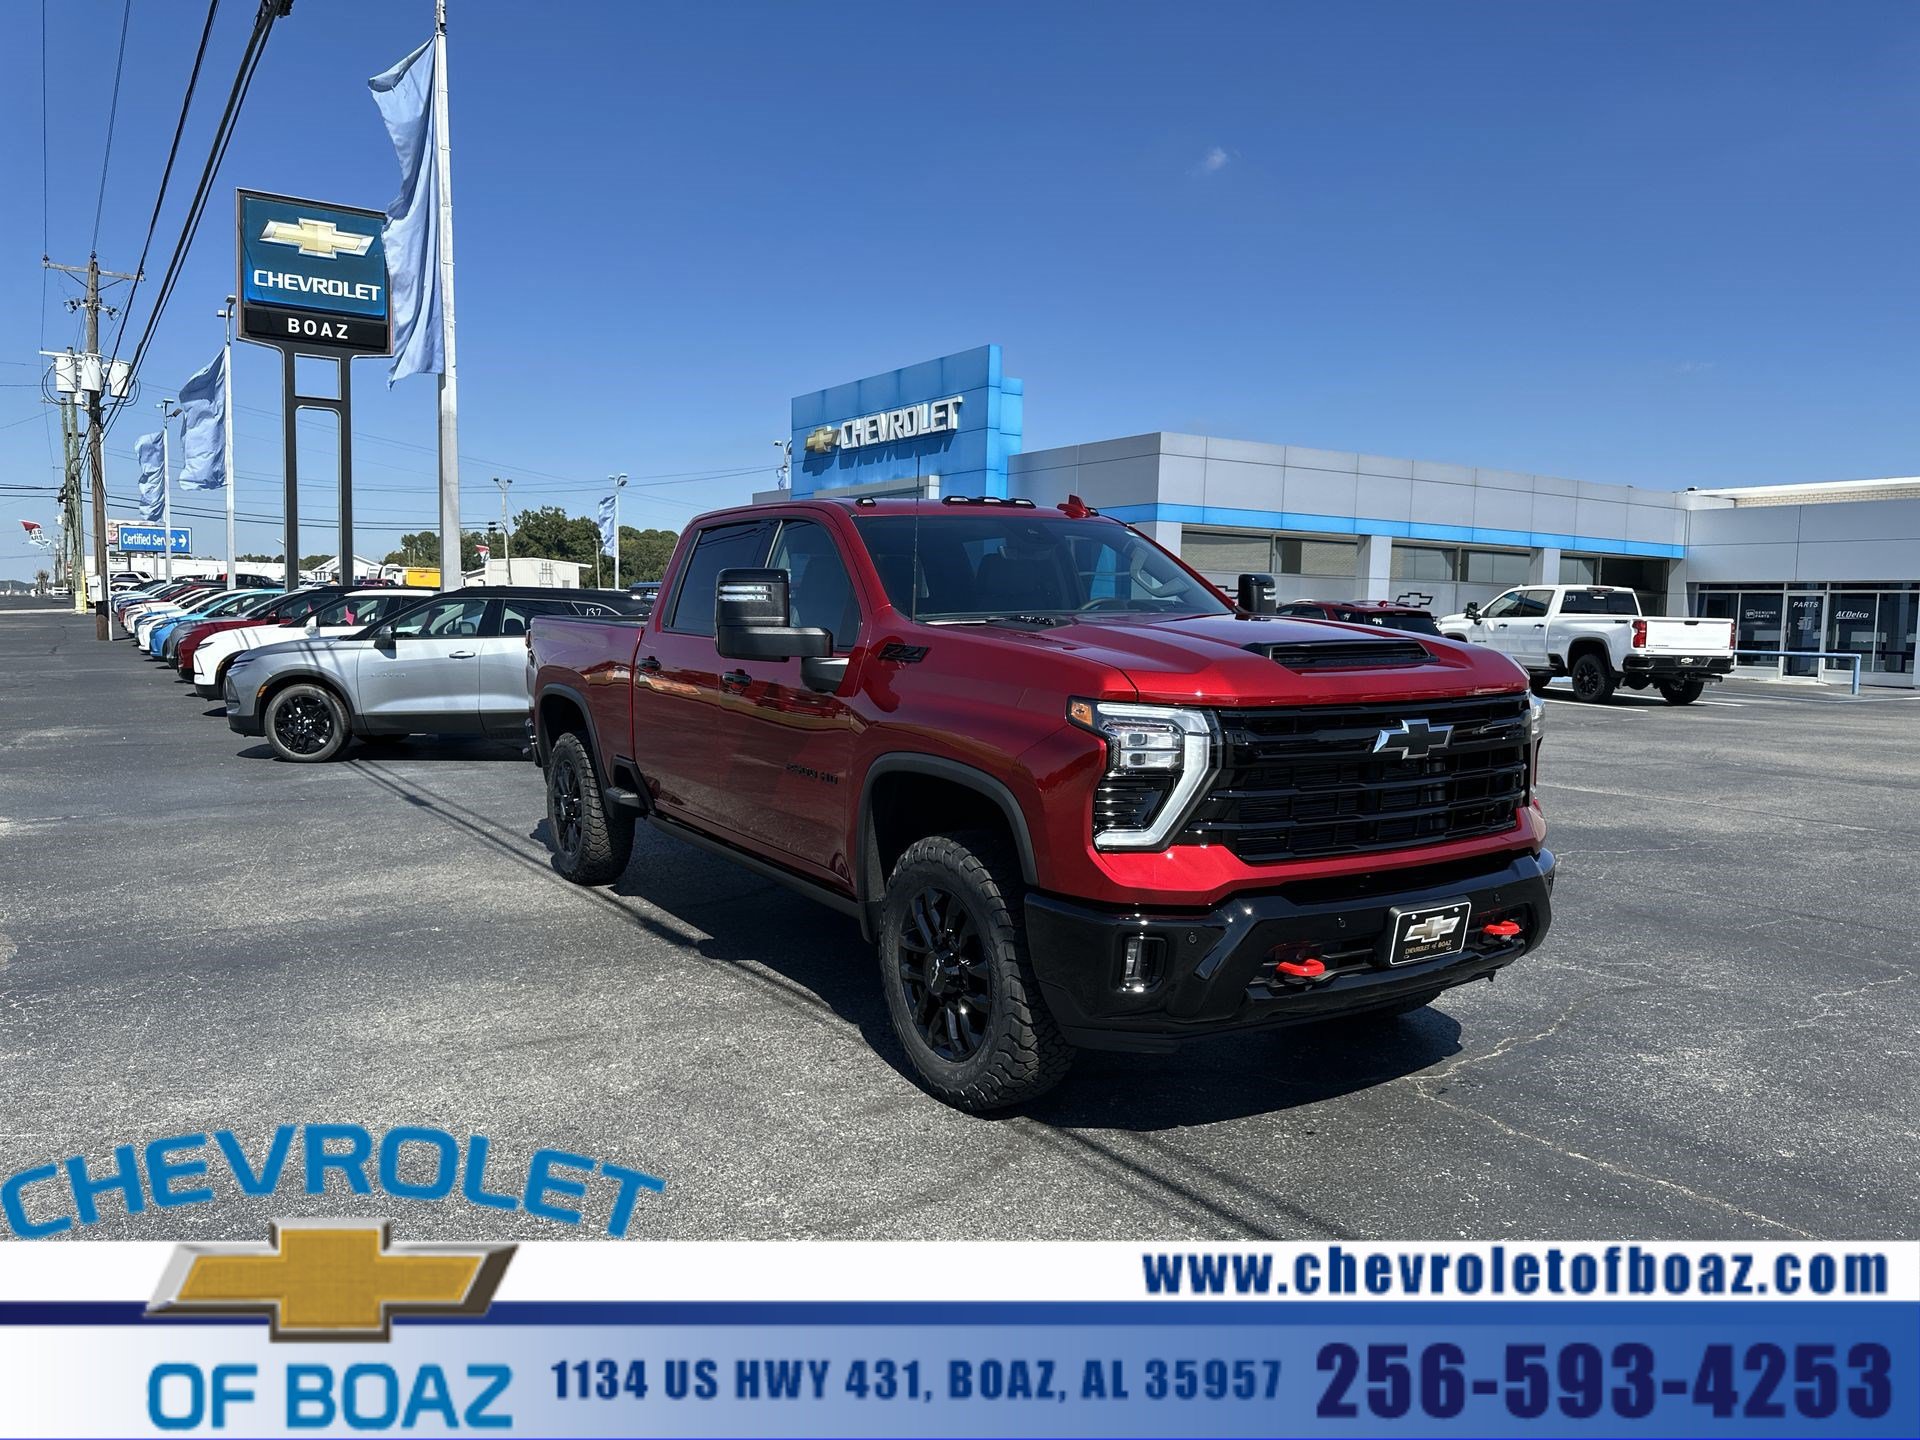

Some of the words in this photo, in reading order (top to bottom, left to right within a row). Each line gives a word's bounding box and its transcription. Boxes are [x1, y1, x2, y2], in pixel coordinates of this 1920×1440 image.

[253, 269, 382, 301] CHEVROLET
[287, 318, 349, 340] BOAZ
[840, 395, 963, 450] CHEVROLET
[123, 533, 151, 545] Certified
[586, 608, 602, 616] 137
[1836, 611, 1869, 619] ACDelco
